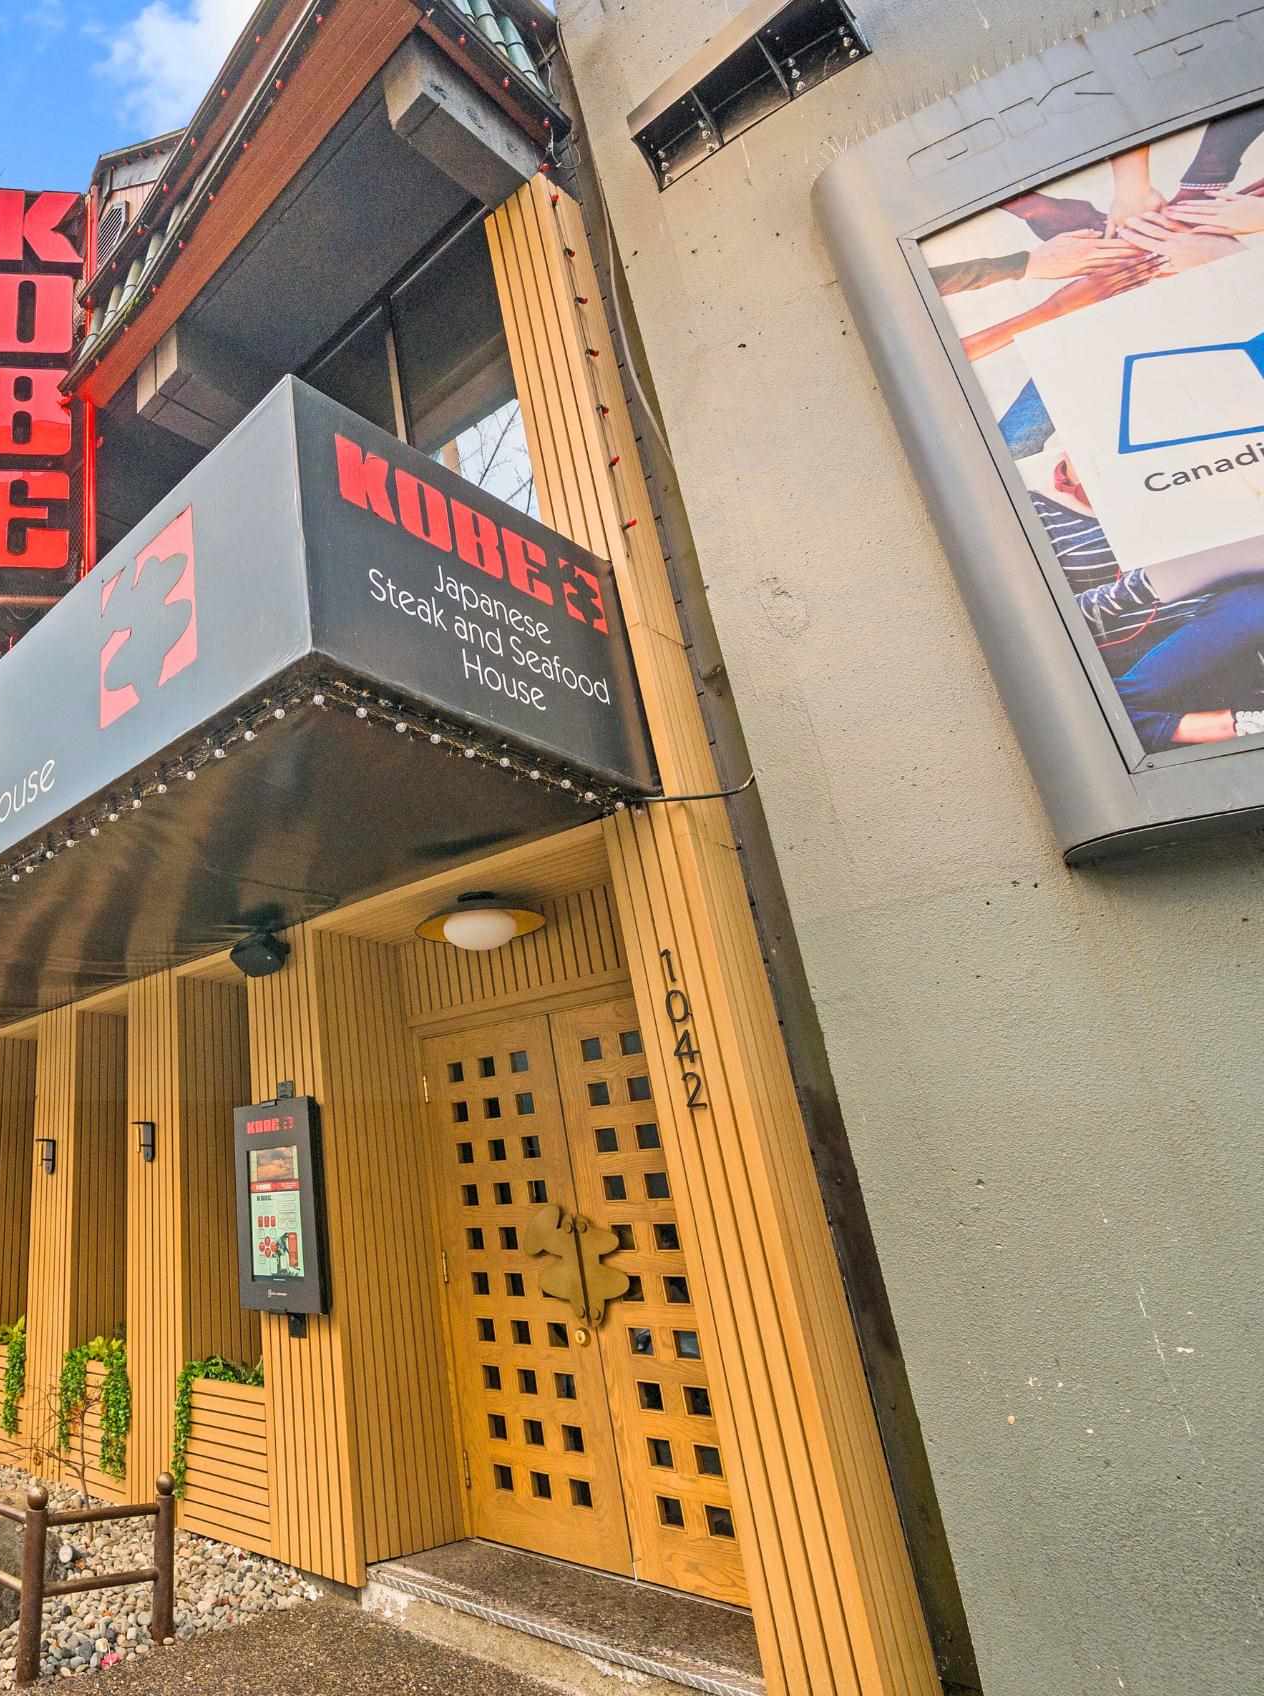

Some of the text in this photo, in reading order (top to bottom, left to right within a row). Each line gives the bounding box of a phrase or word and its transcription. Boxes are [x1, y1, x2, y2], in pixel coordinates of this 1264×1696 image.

[334, 432, 554, 607] KOBE
[368, 568, 611, 705] Steak and Seafood
[433, 565, 551, 644] Japanese
[461, 648, 546, 711] House
[659, 949, 708, 1110] 1042
